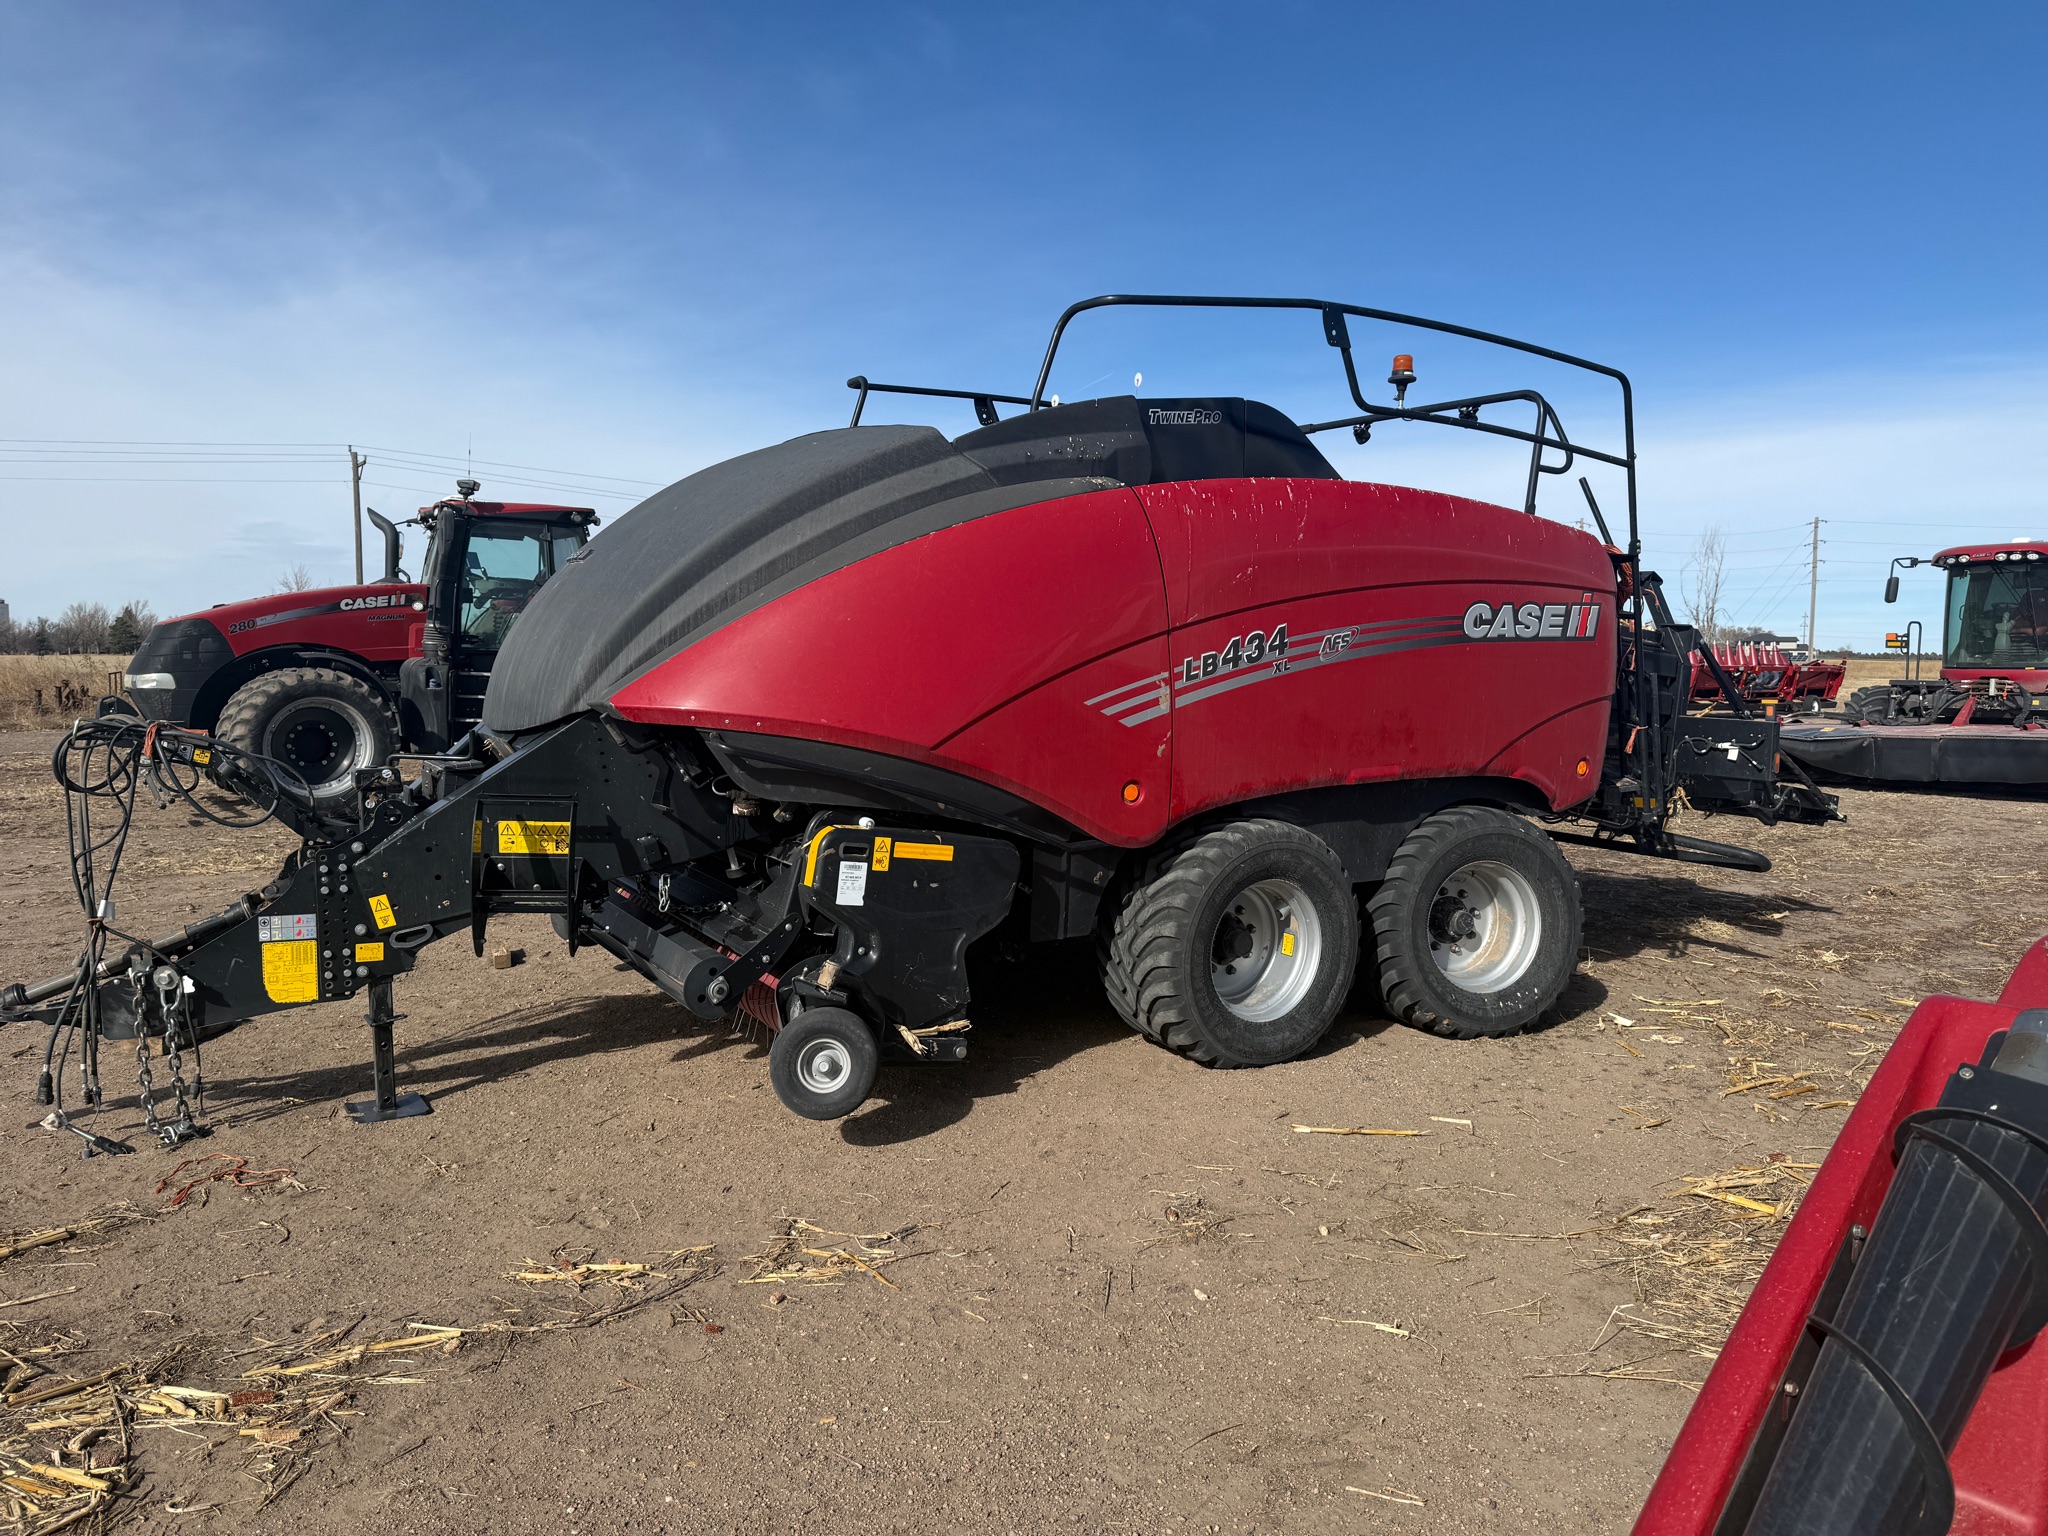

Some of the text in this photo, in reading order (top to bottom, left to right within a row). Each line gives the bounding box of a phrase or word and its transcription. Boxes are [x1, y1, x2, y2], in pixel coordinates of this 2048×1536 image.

[367, 613, 407, 623] MAGNUM
[228, 618, 257, 636] 280
[1183, 623, 1354, 684] LB434 AFS
[1271, 659, 1292, 676] XL
